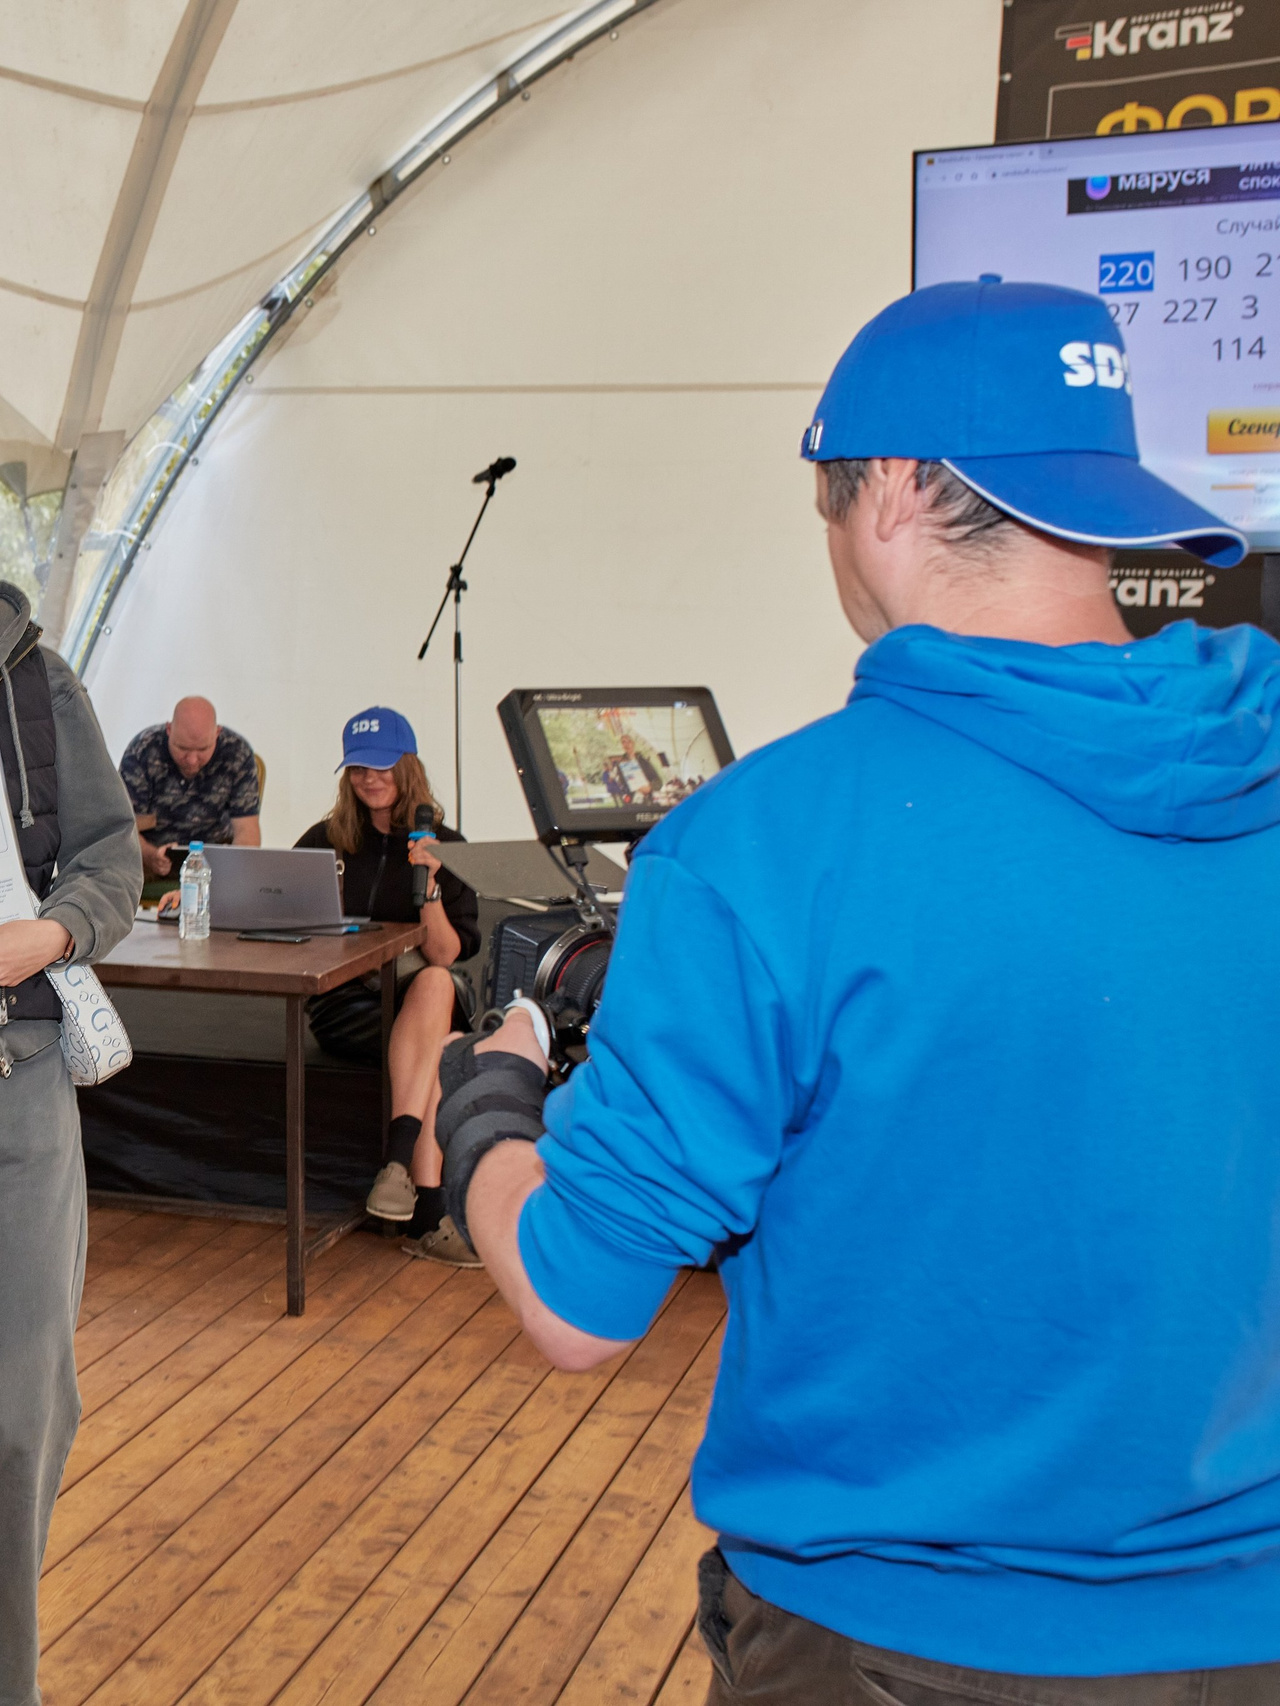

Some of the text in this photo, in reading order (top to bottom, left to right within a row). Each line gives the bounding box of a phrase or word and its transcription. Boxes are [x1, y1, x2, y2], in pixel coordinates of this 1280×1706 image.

[1092, 11, 1234, 59] Kranz
[1118, 167, 1211, 193] маруся
[1100, 253, 1280, 288] 220 190 2
[1163, 297, 1218, 324] 227
[1241, 295, 1258, 320] 3
[1213, 336, 1267, 362] 114
[352, 719, 380, 735] SDS
